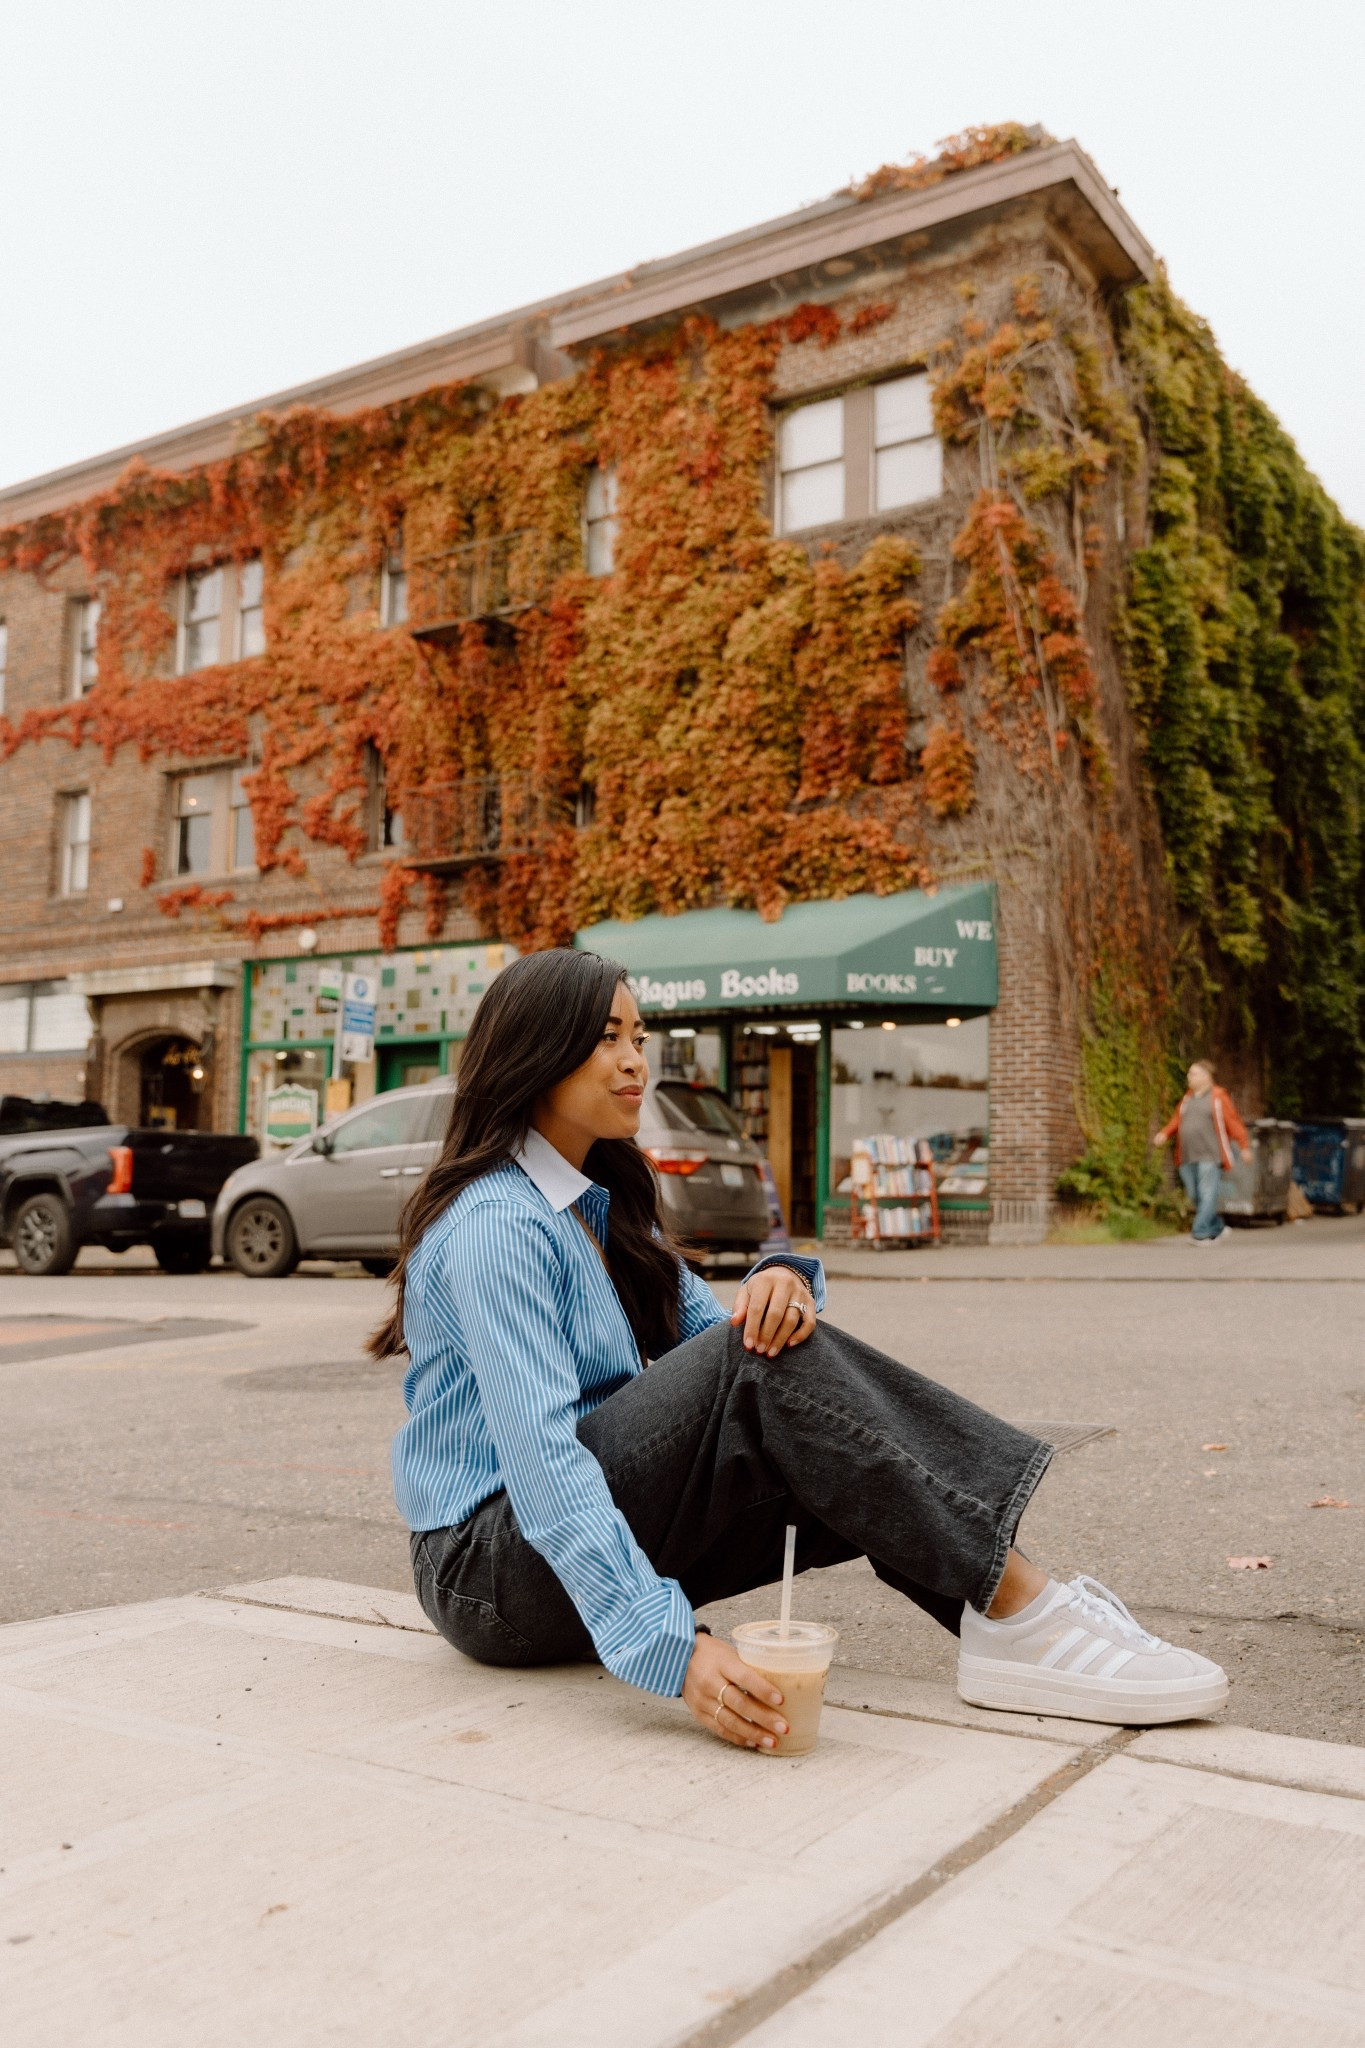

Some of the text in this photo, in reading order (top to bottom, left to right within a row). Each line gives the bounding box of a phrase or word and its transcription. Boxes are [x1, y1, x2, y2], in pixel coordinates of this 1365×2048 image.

[955, 919, 993, 941] WE
[914, 946, 958, 968] BUY
[720, 966, 799, 998] Books
[846, 972, 918, 994] BOOKS
